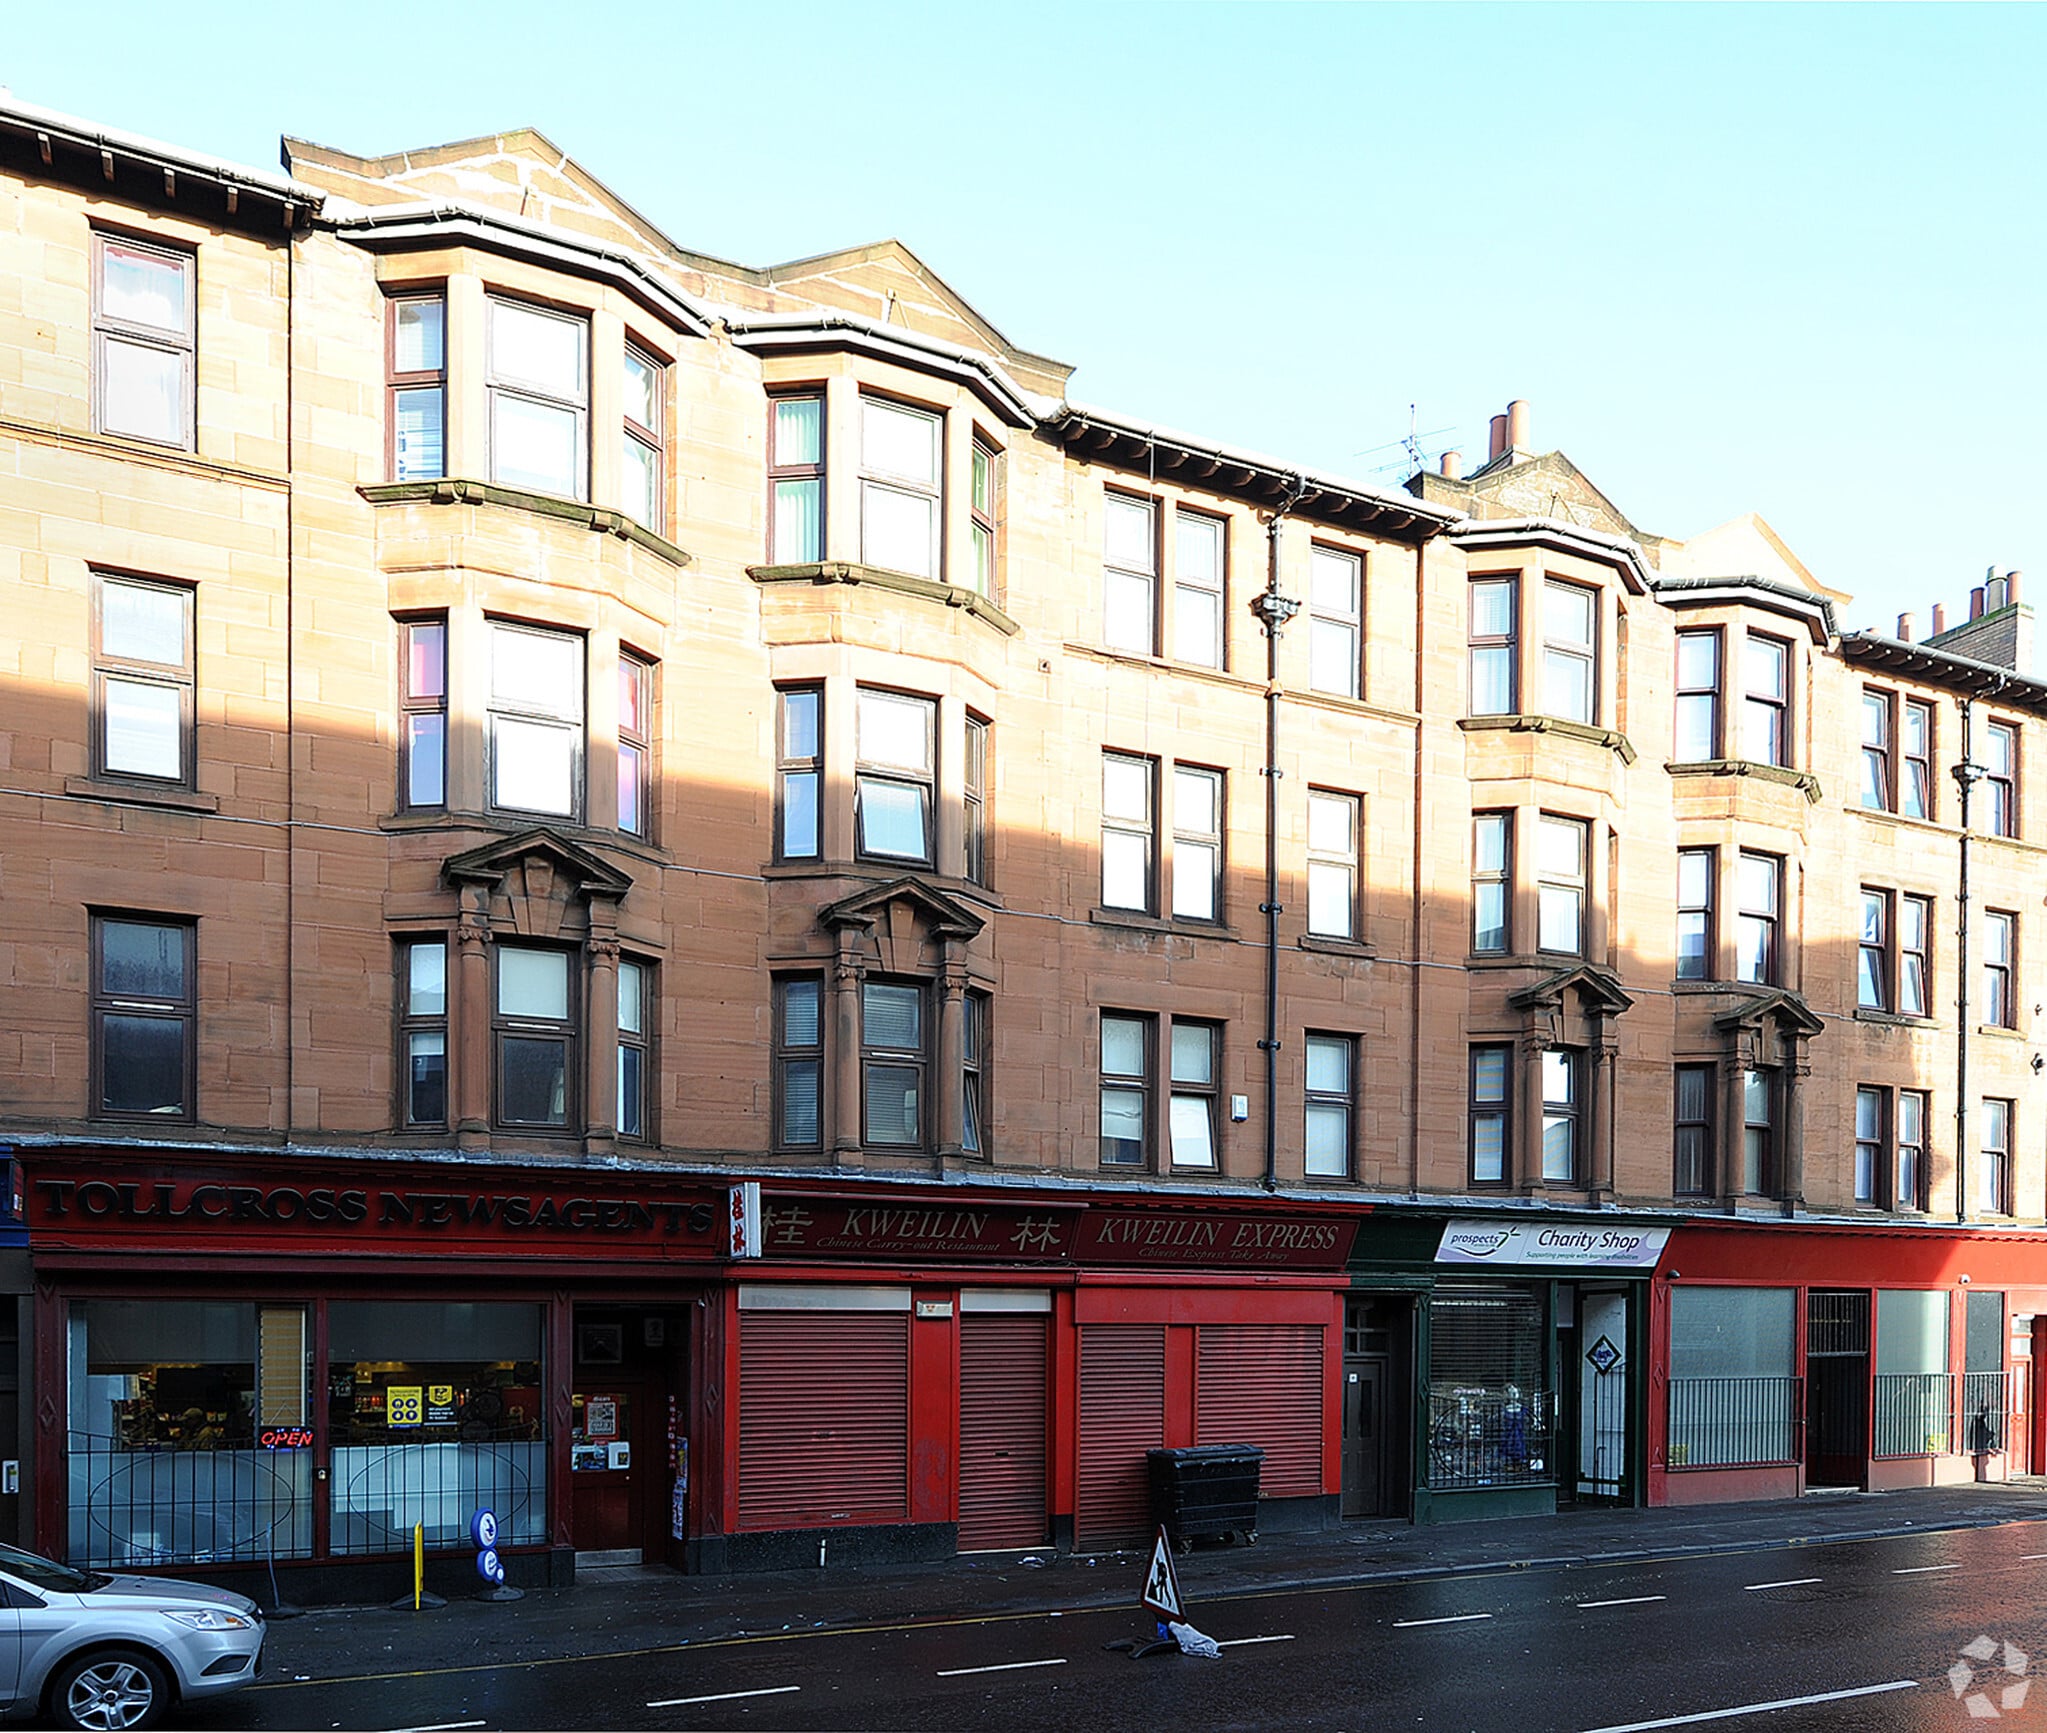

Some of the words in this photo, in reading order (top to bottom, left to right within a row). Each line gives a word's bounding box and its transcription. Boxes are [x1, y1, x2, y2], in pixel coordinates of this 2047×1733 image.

[35, 1180, 368, 1222] TOLLCROSS
[379, 1191, 715, 1234] NEWSAGENTS
[762, 1205, 814, 1246] 桂
[839, 1208, 991, 1240] KWEILIN
[1010, 1216, 1061, 1252] 林
[1096, 1218, 1225, 1247] KWEILIN
[1231, 1223, 1339, 1250] EXPRESS
[816, 1236, 863, 1248] Chinese
[1137, 1246, 1178, 1258] Chinese
[1182, 1248, 1226, 1261] Express
[1450, 1235, 1499, 1246] prospects
[1538, 1229, 1597, 1251] Charity
[1600, 1231, 1640, 1252] Shop
[261, 1431, 314, 1446] OPEN
